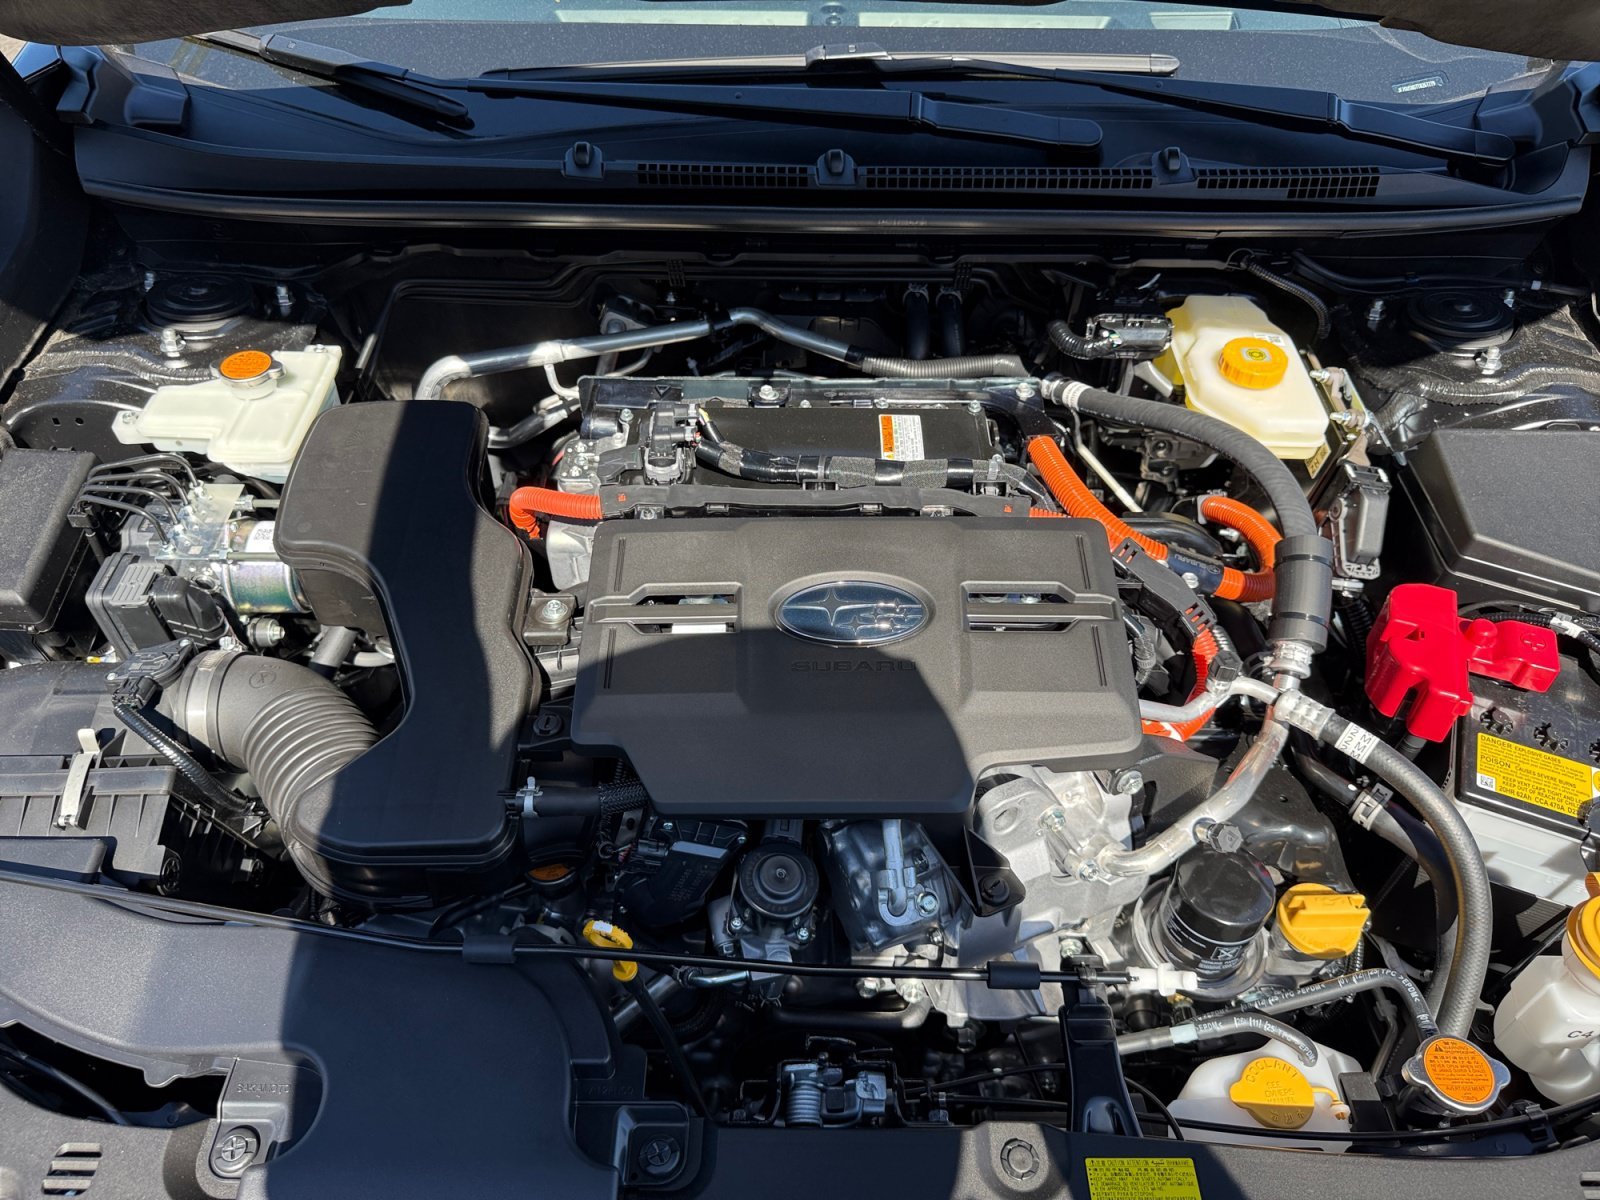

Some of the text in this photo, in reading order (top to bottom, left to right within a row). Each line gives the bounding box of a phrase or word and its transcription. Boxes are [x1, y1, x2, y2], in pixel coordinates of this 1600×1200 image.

[791, 660, 917, 672] SUBARU
[1480, 734, 1513, 750] DANGER
[1480, 754, 1511, 769] POISON
[1515, 764, 1536, 777] CAUSES
[1536, 772, 1558, 782] SEVERE
[1558, 778, 1577, 789] BURNS
[1531, 784, 1546, 793] CAPS
[1499, 786, 1515, 796] 20HR
[1534, 796, 1549, 807] CCA
[1549, 801, 1565, 812] 470A
[1245, 1059, 1298, 1083] COOLANT
